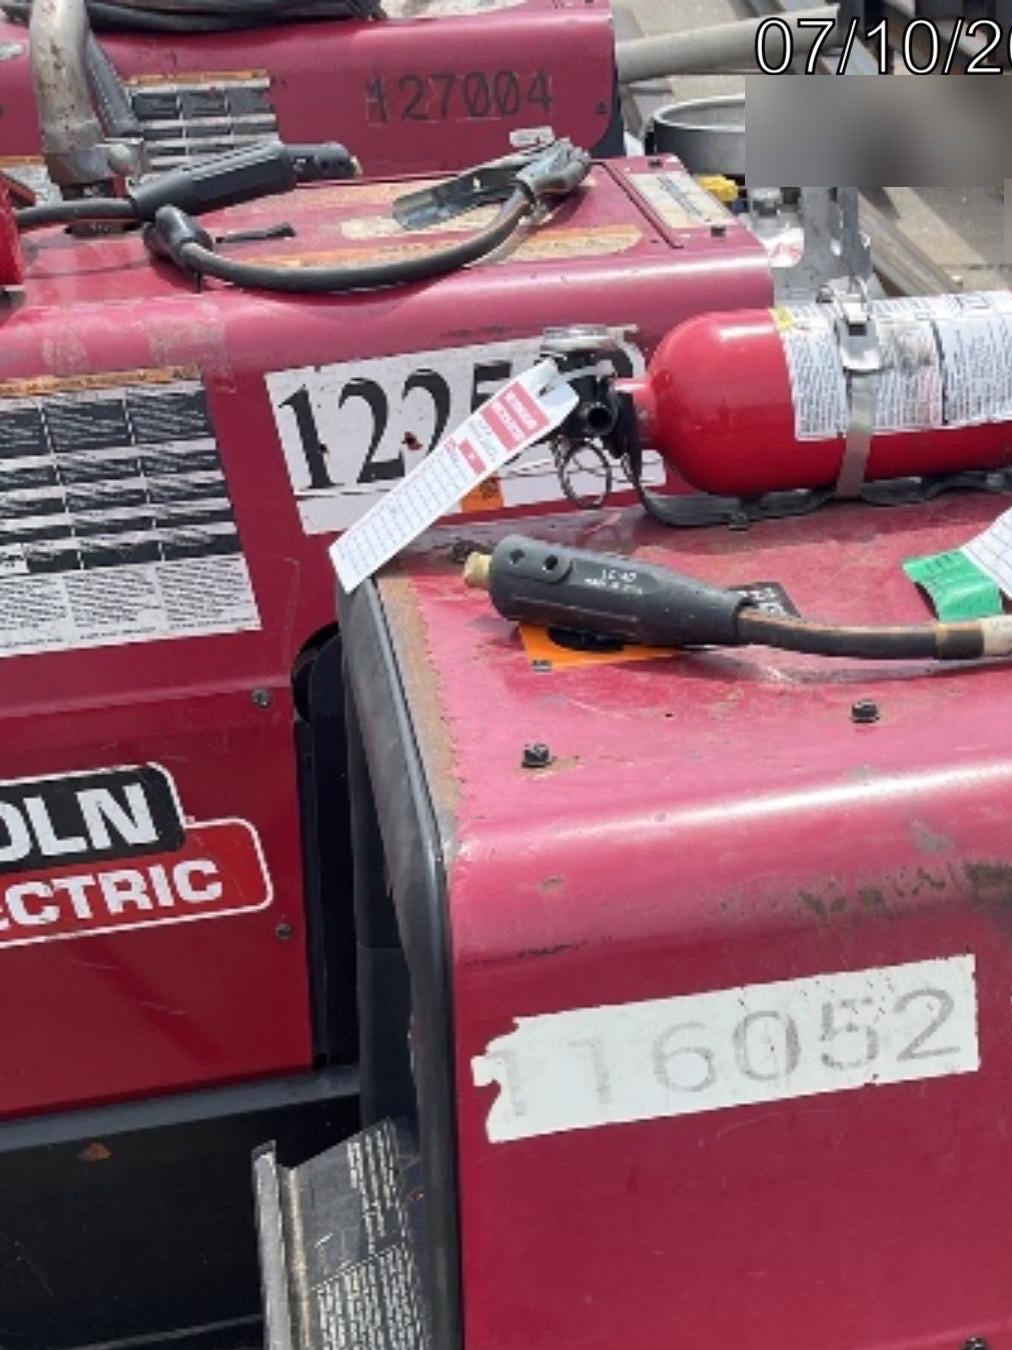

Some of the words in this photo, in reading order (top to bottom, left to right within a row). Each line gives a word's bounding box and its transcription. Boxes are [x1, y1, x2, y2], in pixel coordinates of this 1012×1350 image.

[364, 69, 554, 123] 127004
[0, 860, 223, 931] CTRIC
[493, 985, 961, 1118] 116052
